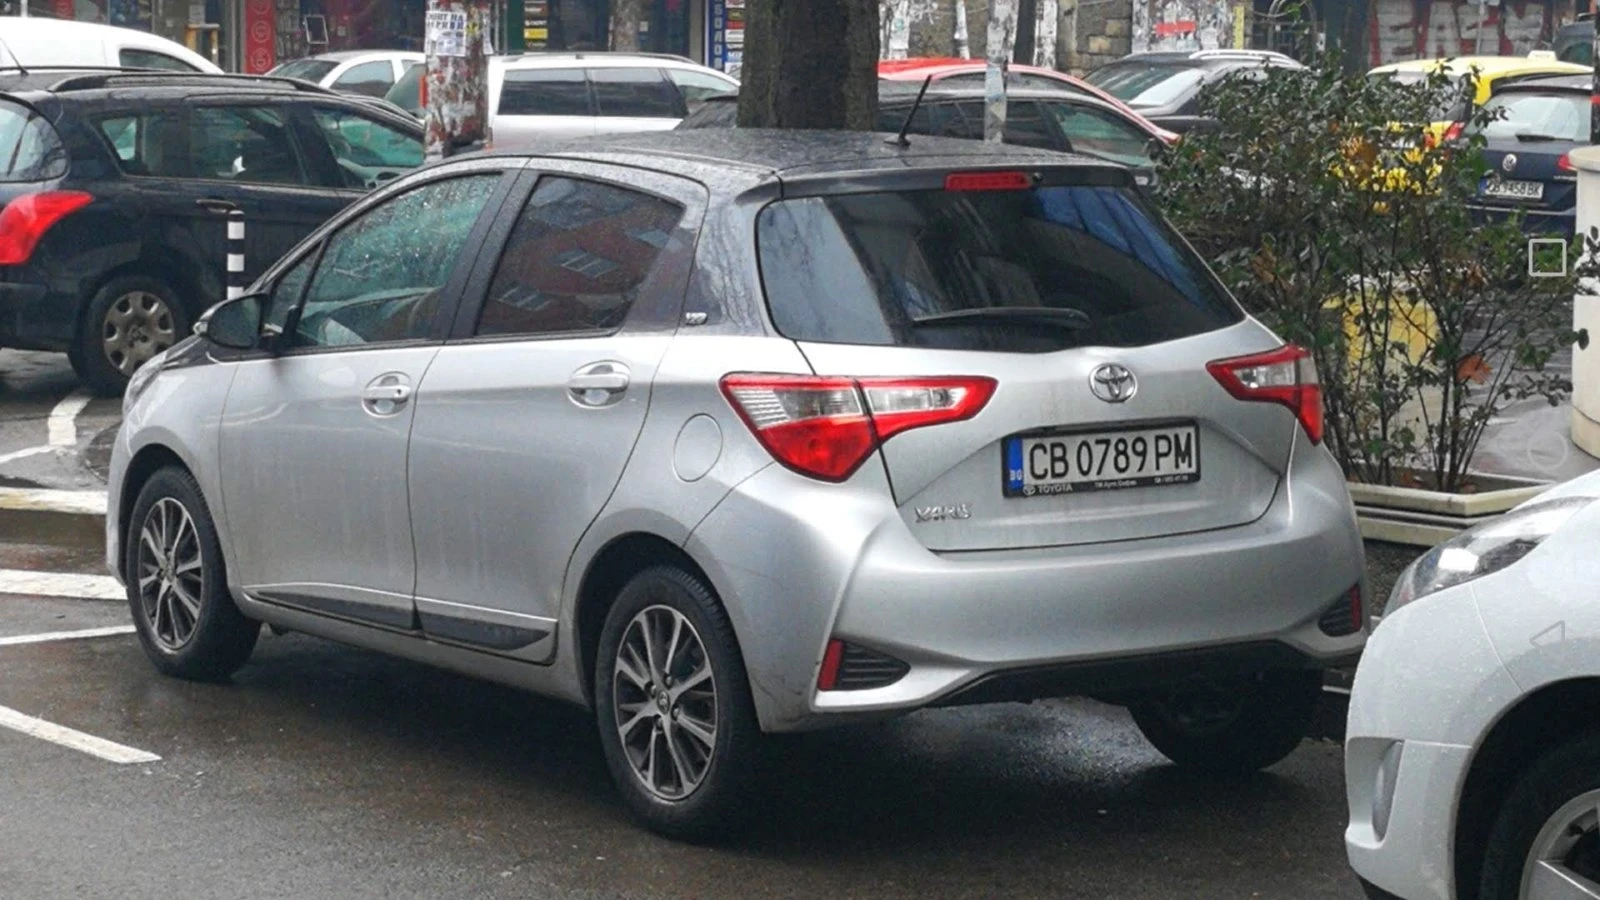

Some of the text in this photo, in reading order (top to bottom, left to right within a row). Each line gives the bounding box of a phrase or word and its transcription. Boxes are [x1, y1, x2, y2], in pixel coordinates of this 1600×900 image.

[1029, 432, 1193, 480] CB 0789 PM
[1010, 469, 1022, 481] BG
[1038, 484, 1073, 494] TOYOTA
